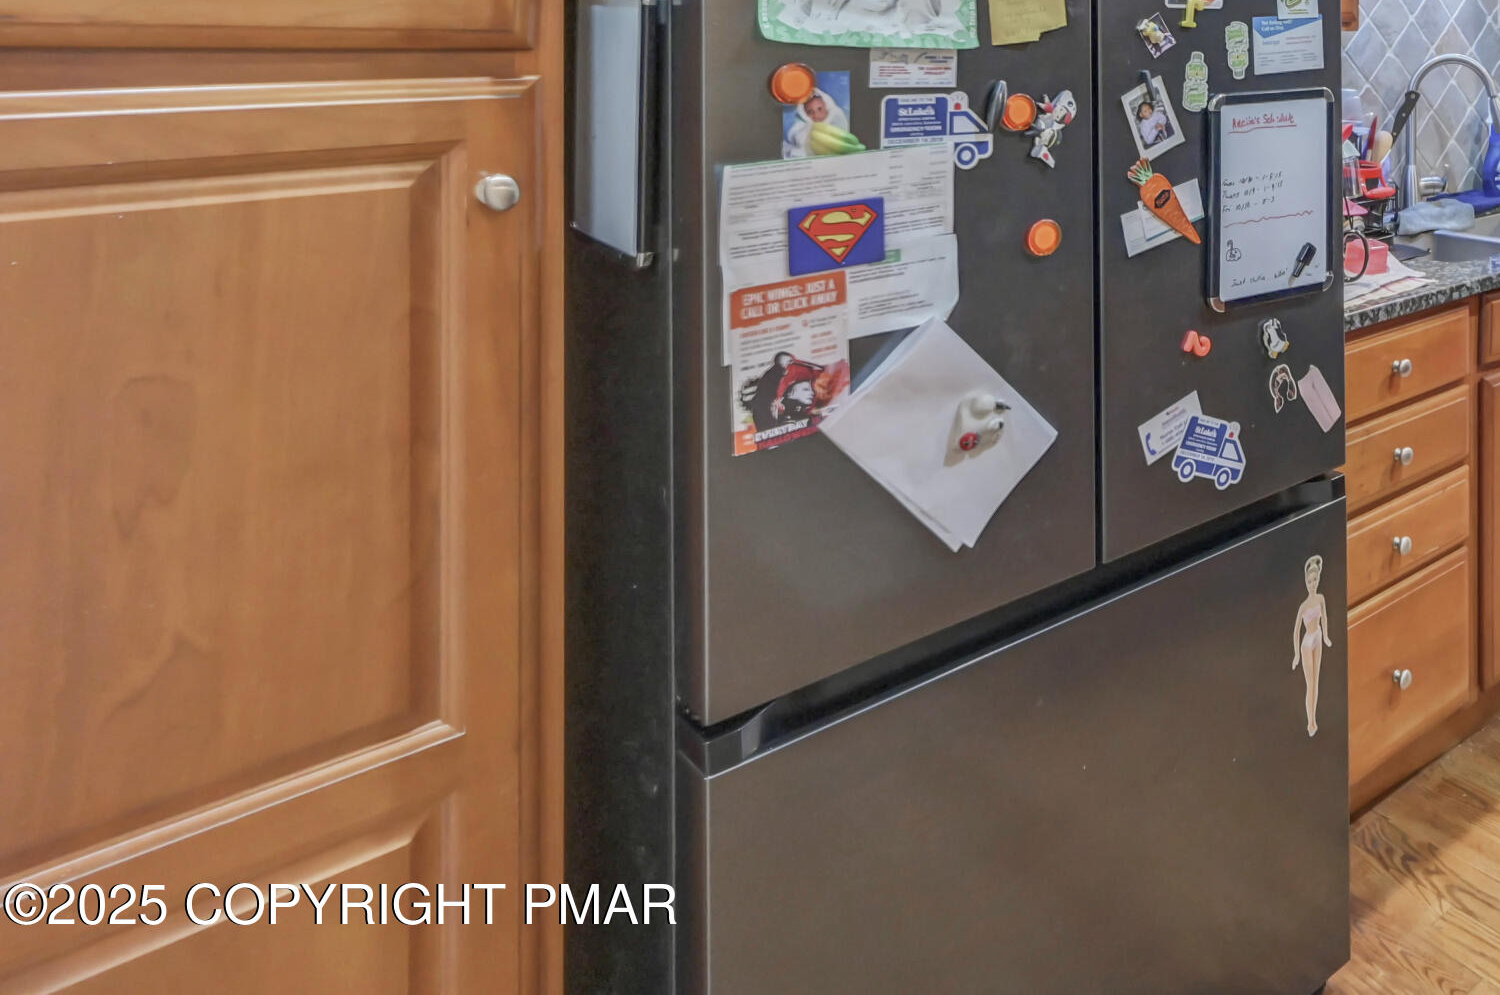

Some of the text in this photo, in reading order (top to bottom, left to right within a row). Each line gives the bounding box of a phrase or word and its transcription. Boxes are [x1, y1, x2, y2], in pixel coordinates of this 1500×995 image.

[743, 291, 764, 306] EPIC
[806, 280, 826, 294] JUST
[828, 278, 836, 290] A
[767, 302, 781, 315] OR
[783, 297, 809, 312] CLICK
